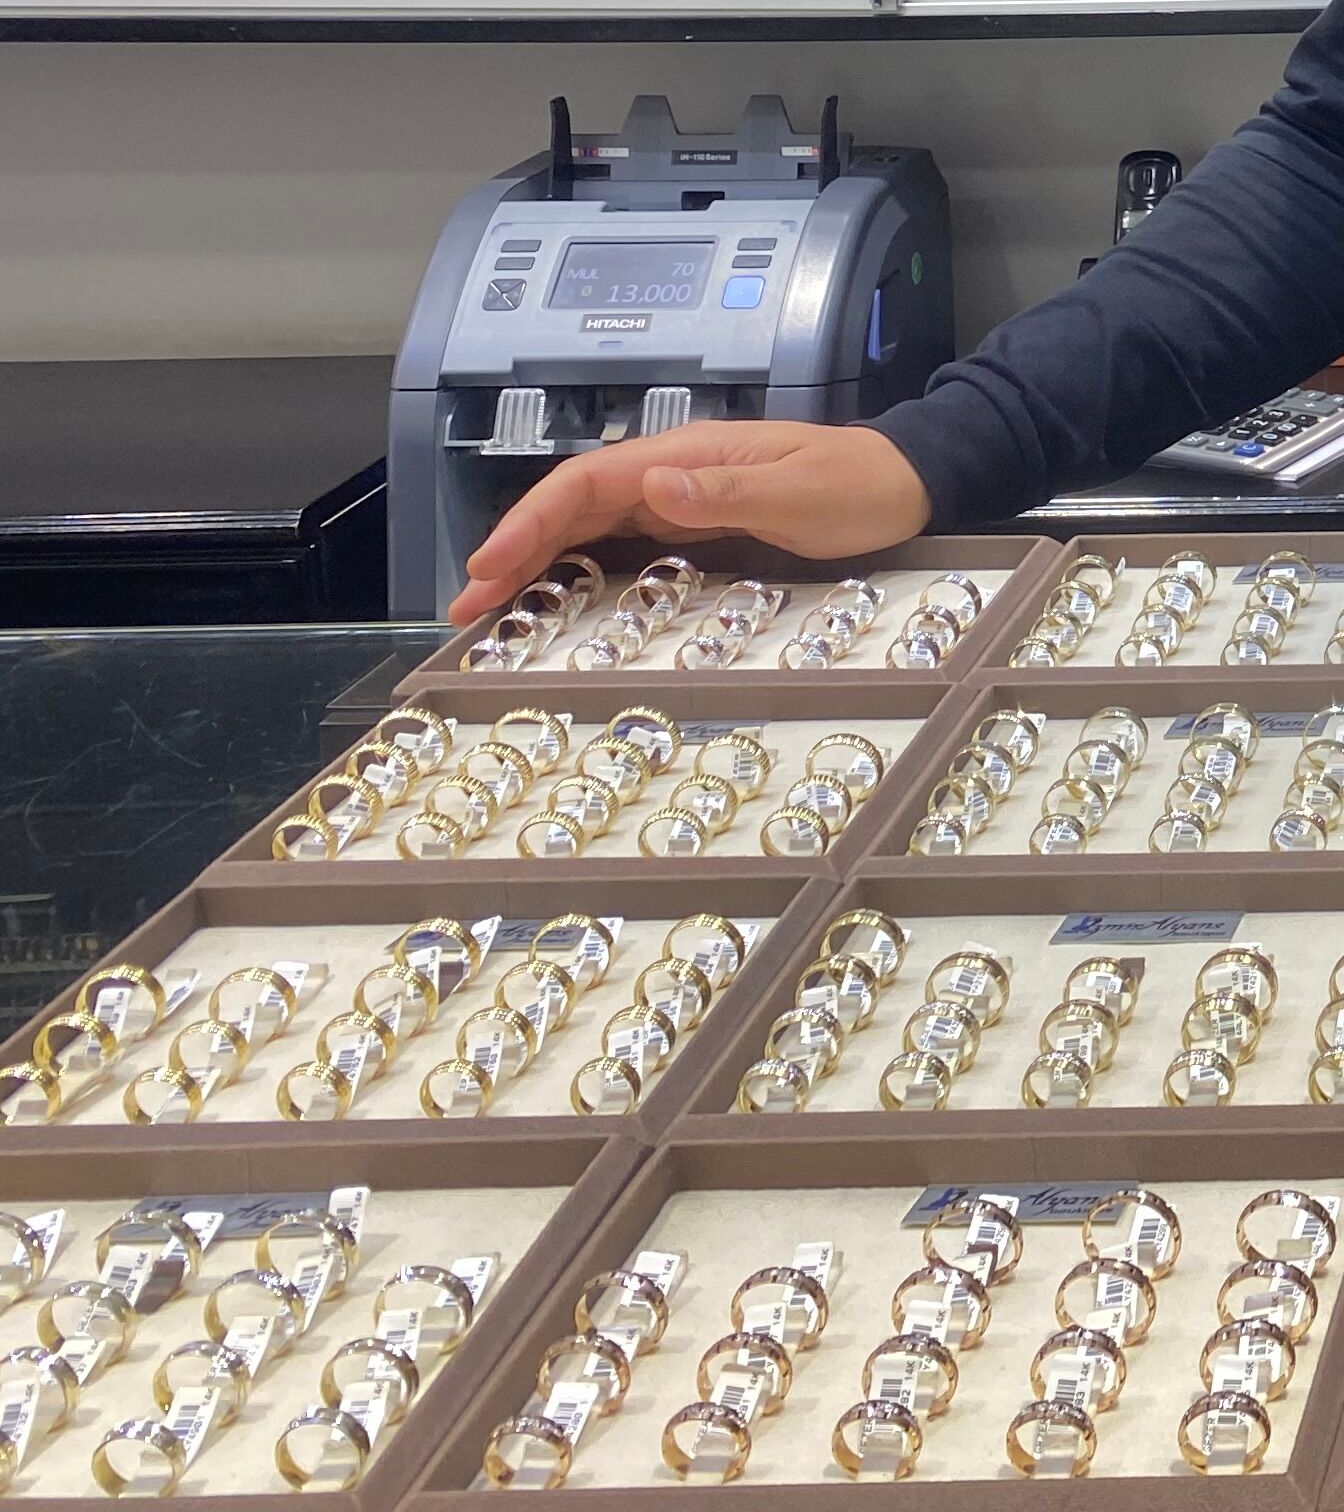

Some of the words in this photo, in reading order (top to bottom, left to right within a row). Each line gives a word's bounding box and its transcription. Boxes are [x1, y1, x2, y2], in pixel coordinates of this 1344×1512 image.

[672, 263, 695, 276] 70
[606, 285, 692, 304] 13,000
[586, 319, 646, 329] HITACHI
